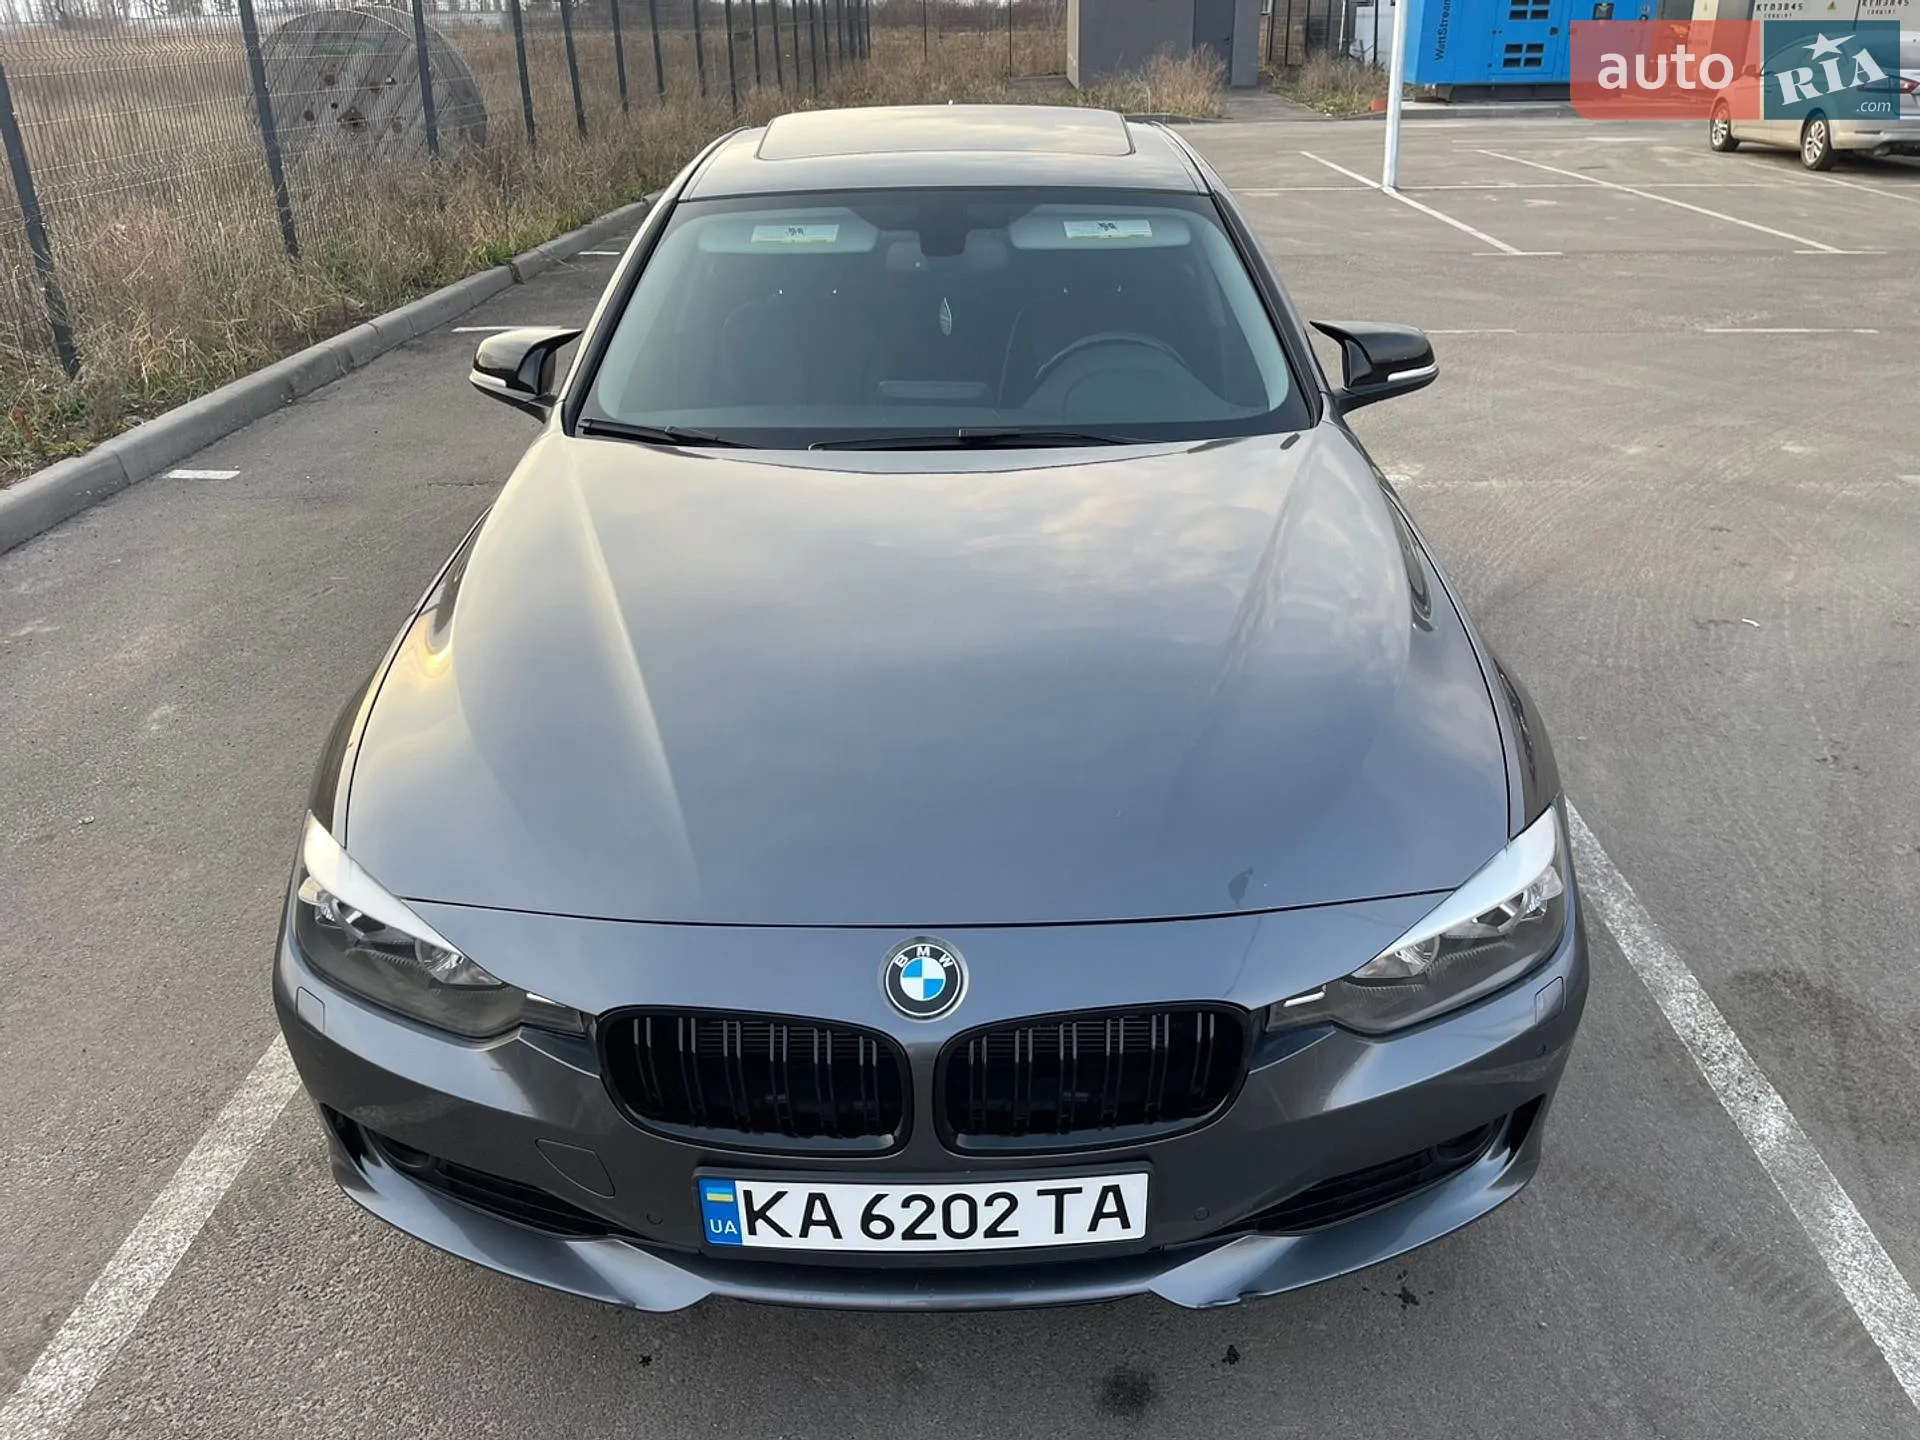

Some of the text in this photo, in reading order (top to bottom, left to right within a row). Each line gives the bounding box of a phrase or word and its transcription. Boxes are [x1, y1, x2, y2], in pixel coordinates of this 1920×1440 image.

[894, 945, 954, 969] BMW
[743, 1183, 1132, 1241] KA 6202 TA
[709, 1218, 738, 1235] UA
